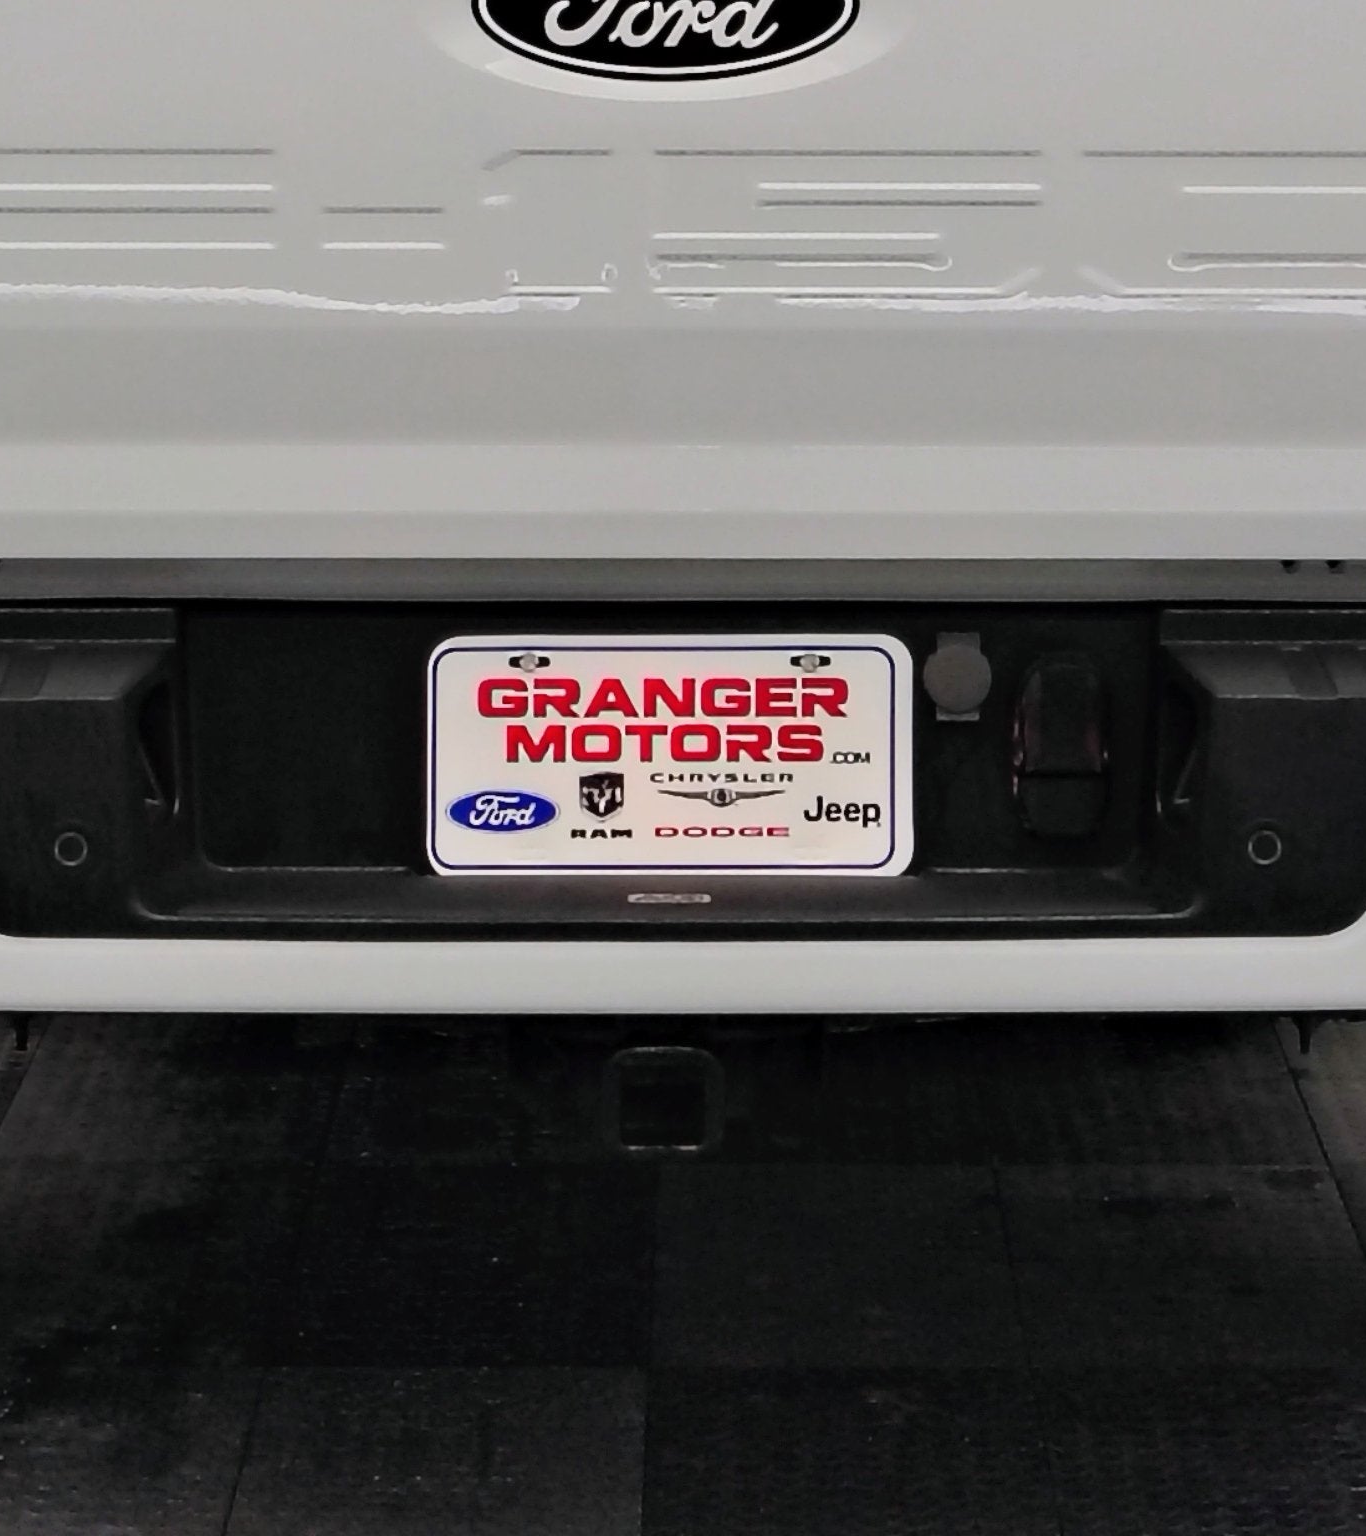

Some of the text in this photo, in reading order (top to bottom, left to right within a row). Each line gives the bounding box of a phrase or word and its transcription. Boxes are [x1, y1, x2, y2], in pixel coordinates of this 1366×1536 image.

[477, 677, 849, 719] GRANGER
[506, 724, 825, 764] MOTORS
[649, 772, 794, 784] CHRYSLER
[468, 794, 536, 826] Ford
[803, 796, 882, 827] Jeep
[570, 828, 633, 839] RAM
[654, 826, 791, 838] DODGE
